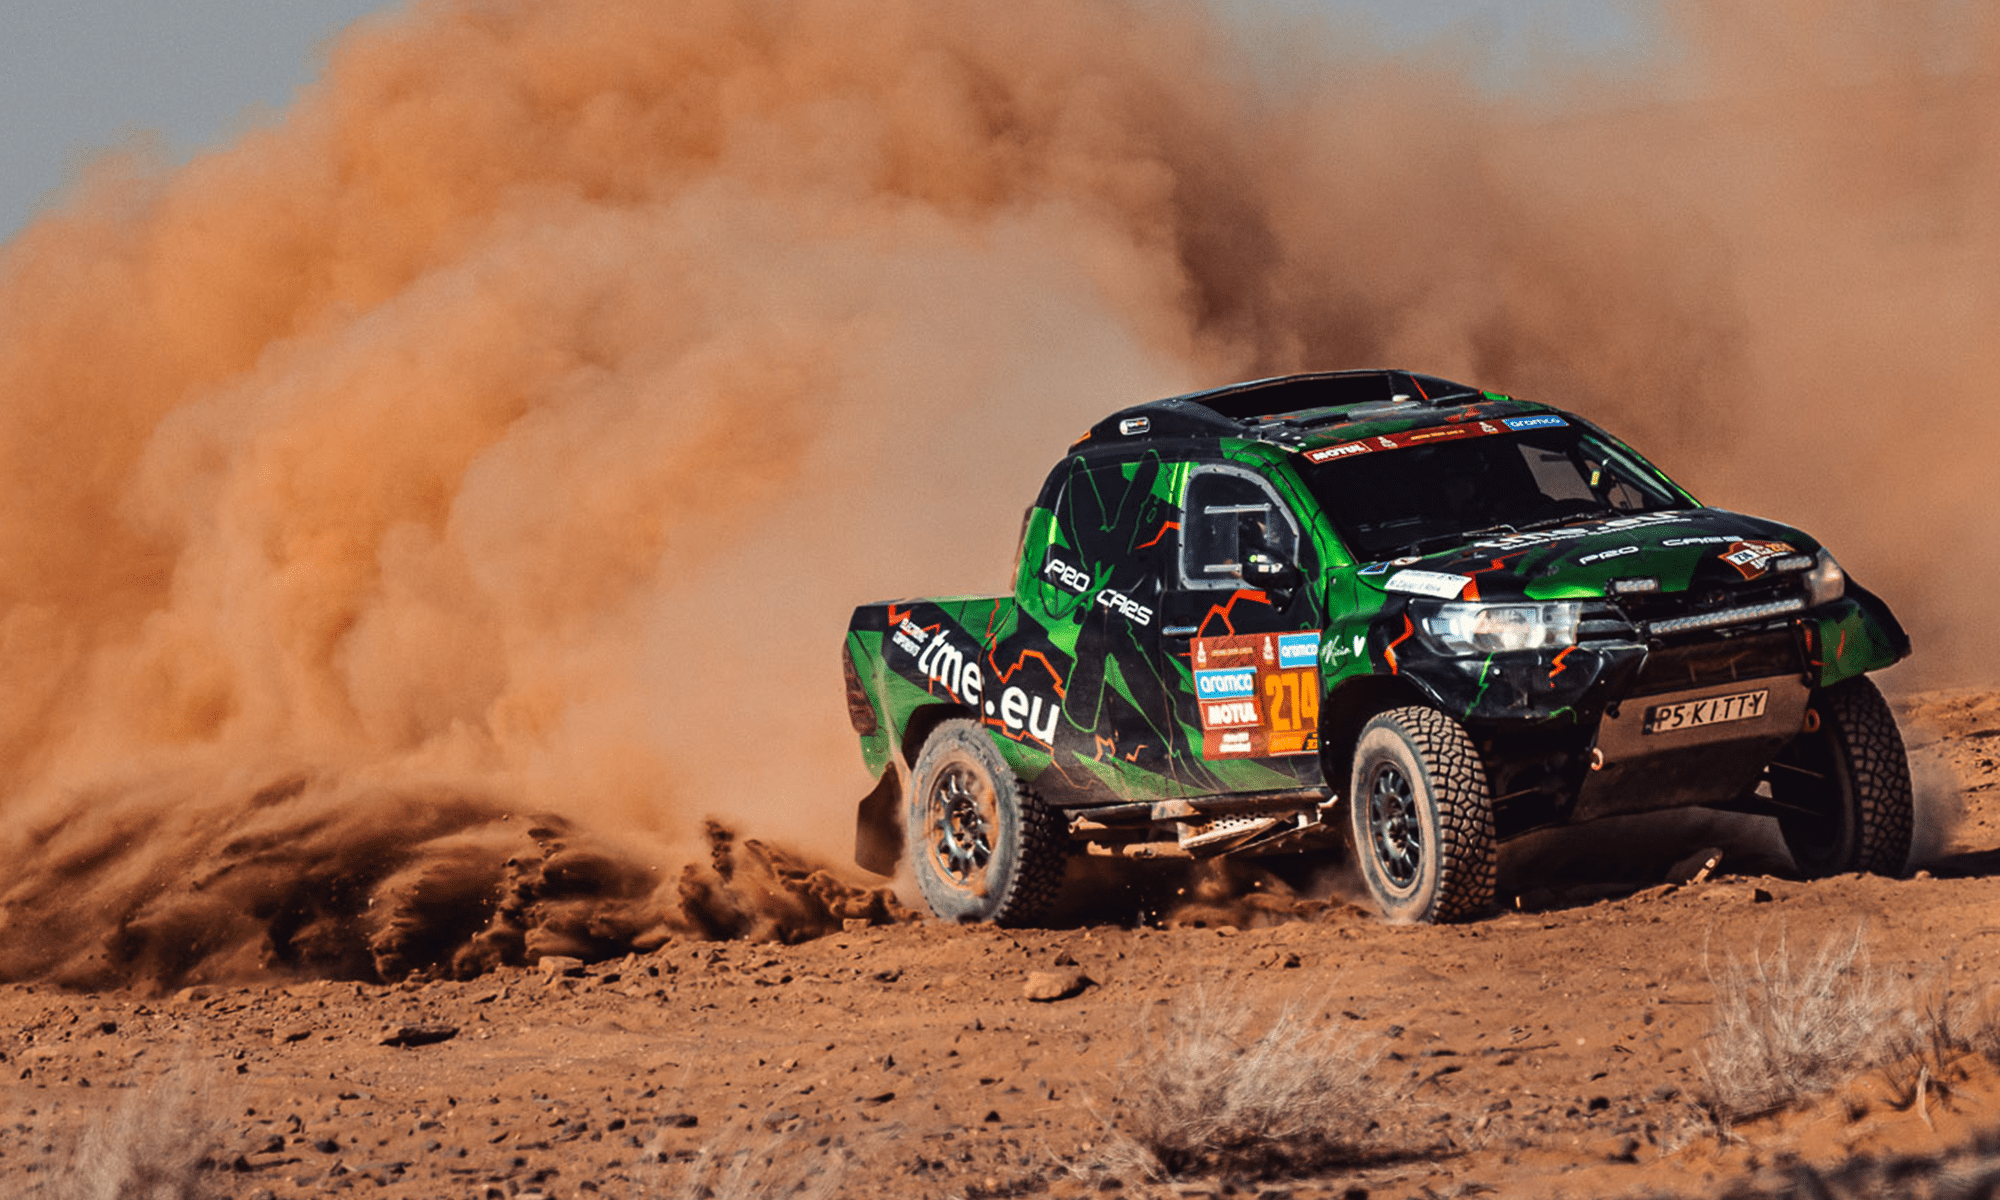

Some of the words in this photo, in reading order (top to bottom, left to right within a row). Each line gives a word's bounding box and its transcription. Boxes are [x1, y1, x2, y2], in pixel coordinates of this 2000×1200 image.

[1510, 418, 1560, 427] aramco
[1312, 444, 1366, 461] MOTUL
[1579, 545, 1639, 565] PRO
[1044, 558, 1090, 592] PRO
[1096, 588, 1153, 626] CARS
[918, 629, 1060, 746] tme.eu
[1200, 673, 1253, 693] aramco
[1265, 672, 1319, 731] 274
[1691, 692, 1765, 725] KITTY
[1208, 702, 1258, 724] MOTUL
